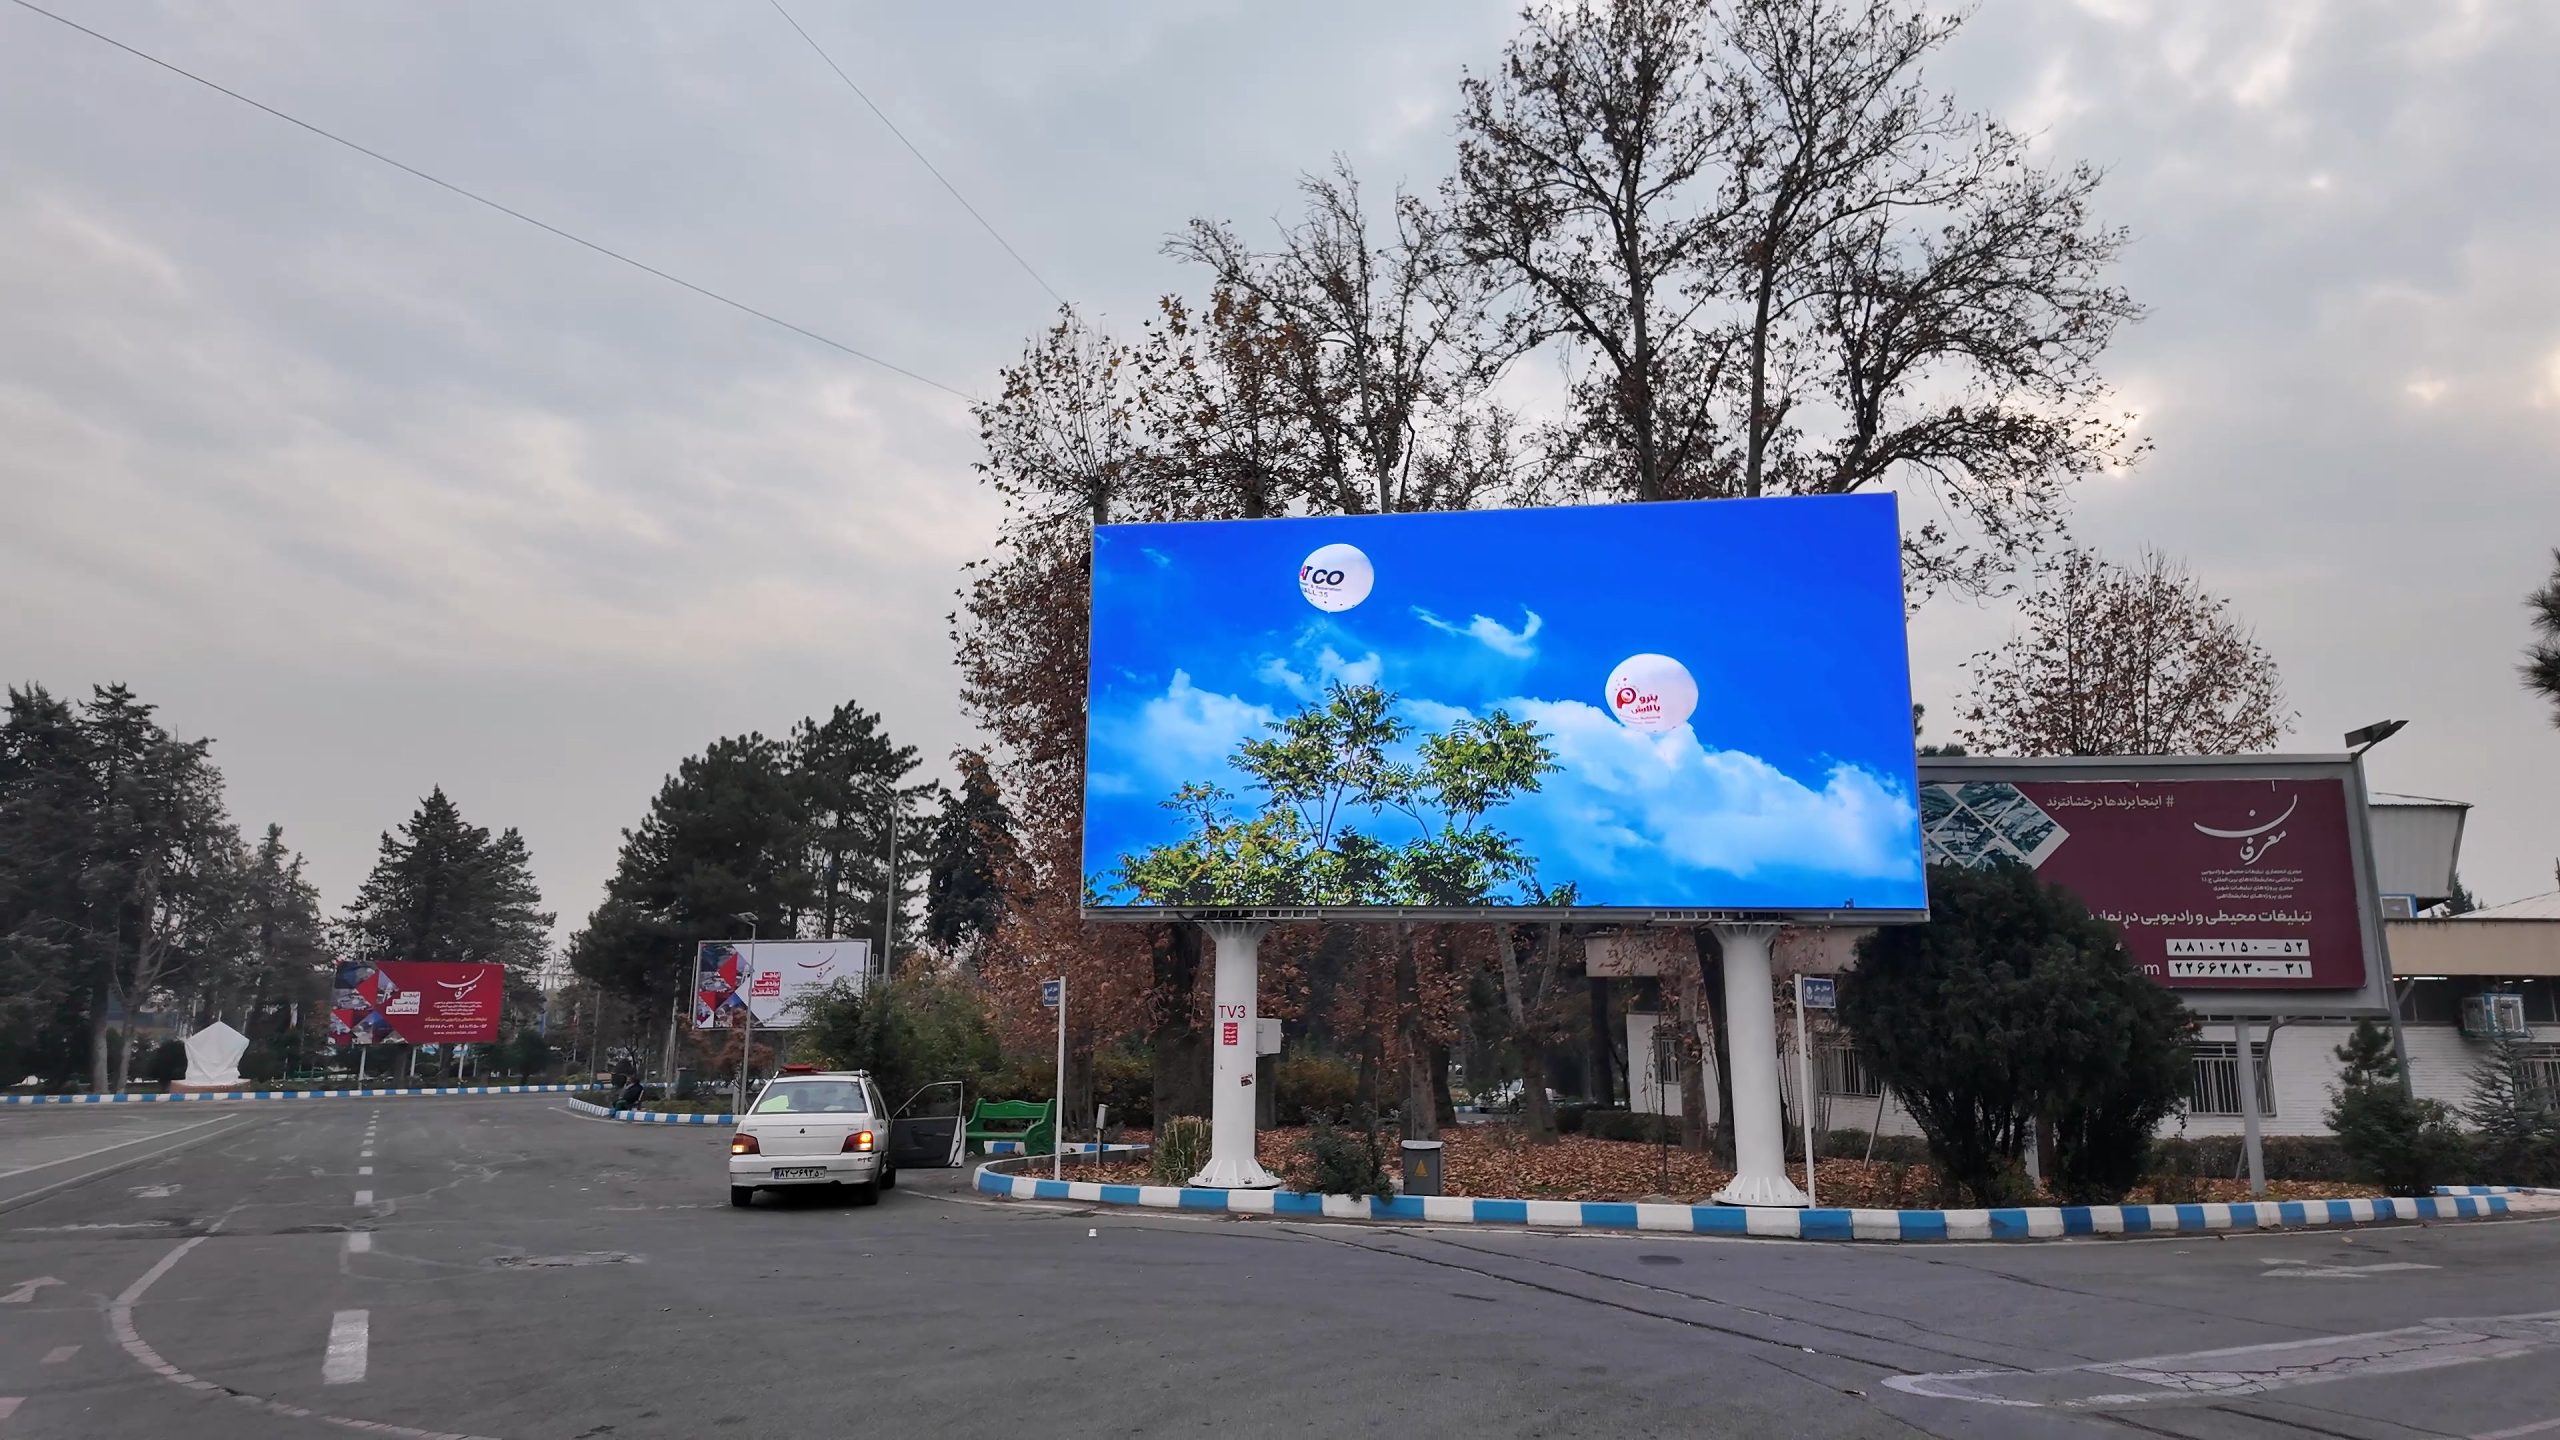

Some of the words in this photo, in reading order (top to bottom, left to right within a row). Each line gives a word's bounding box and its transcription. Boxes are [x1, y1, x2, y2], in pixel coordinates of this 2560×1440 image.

[2104, 795, 2136, 810] برندها
[2137, 795, 2162, 809] اینجا
[2123, 911, 2139, 929] در
[2141, 909, 2194, 926] رادیویی
[2195, 915, 2204, 926] و
[2205, 909, 2256, 926] محیطی
[2258, 909, 2313, 926] تبلیغات
[1218, 1004, 1246, 1019] TV3
